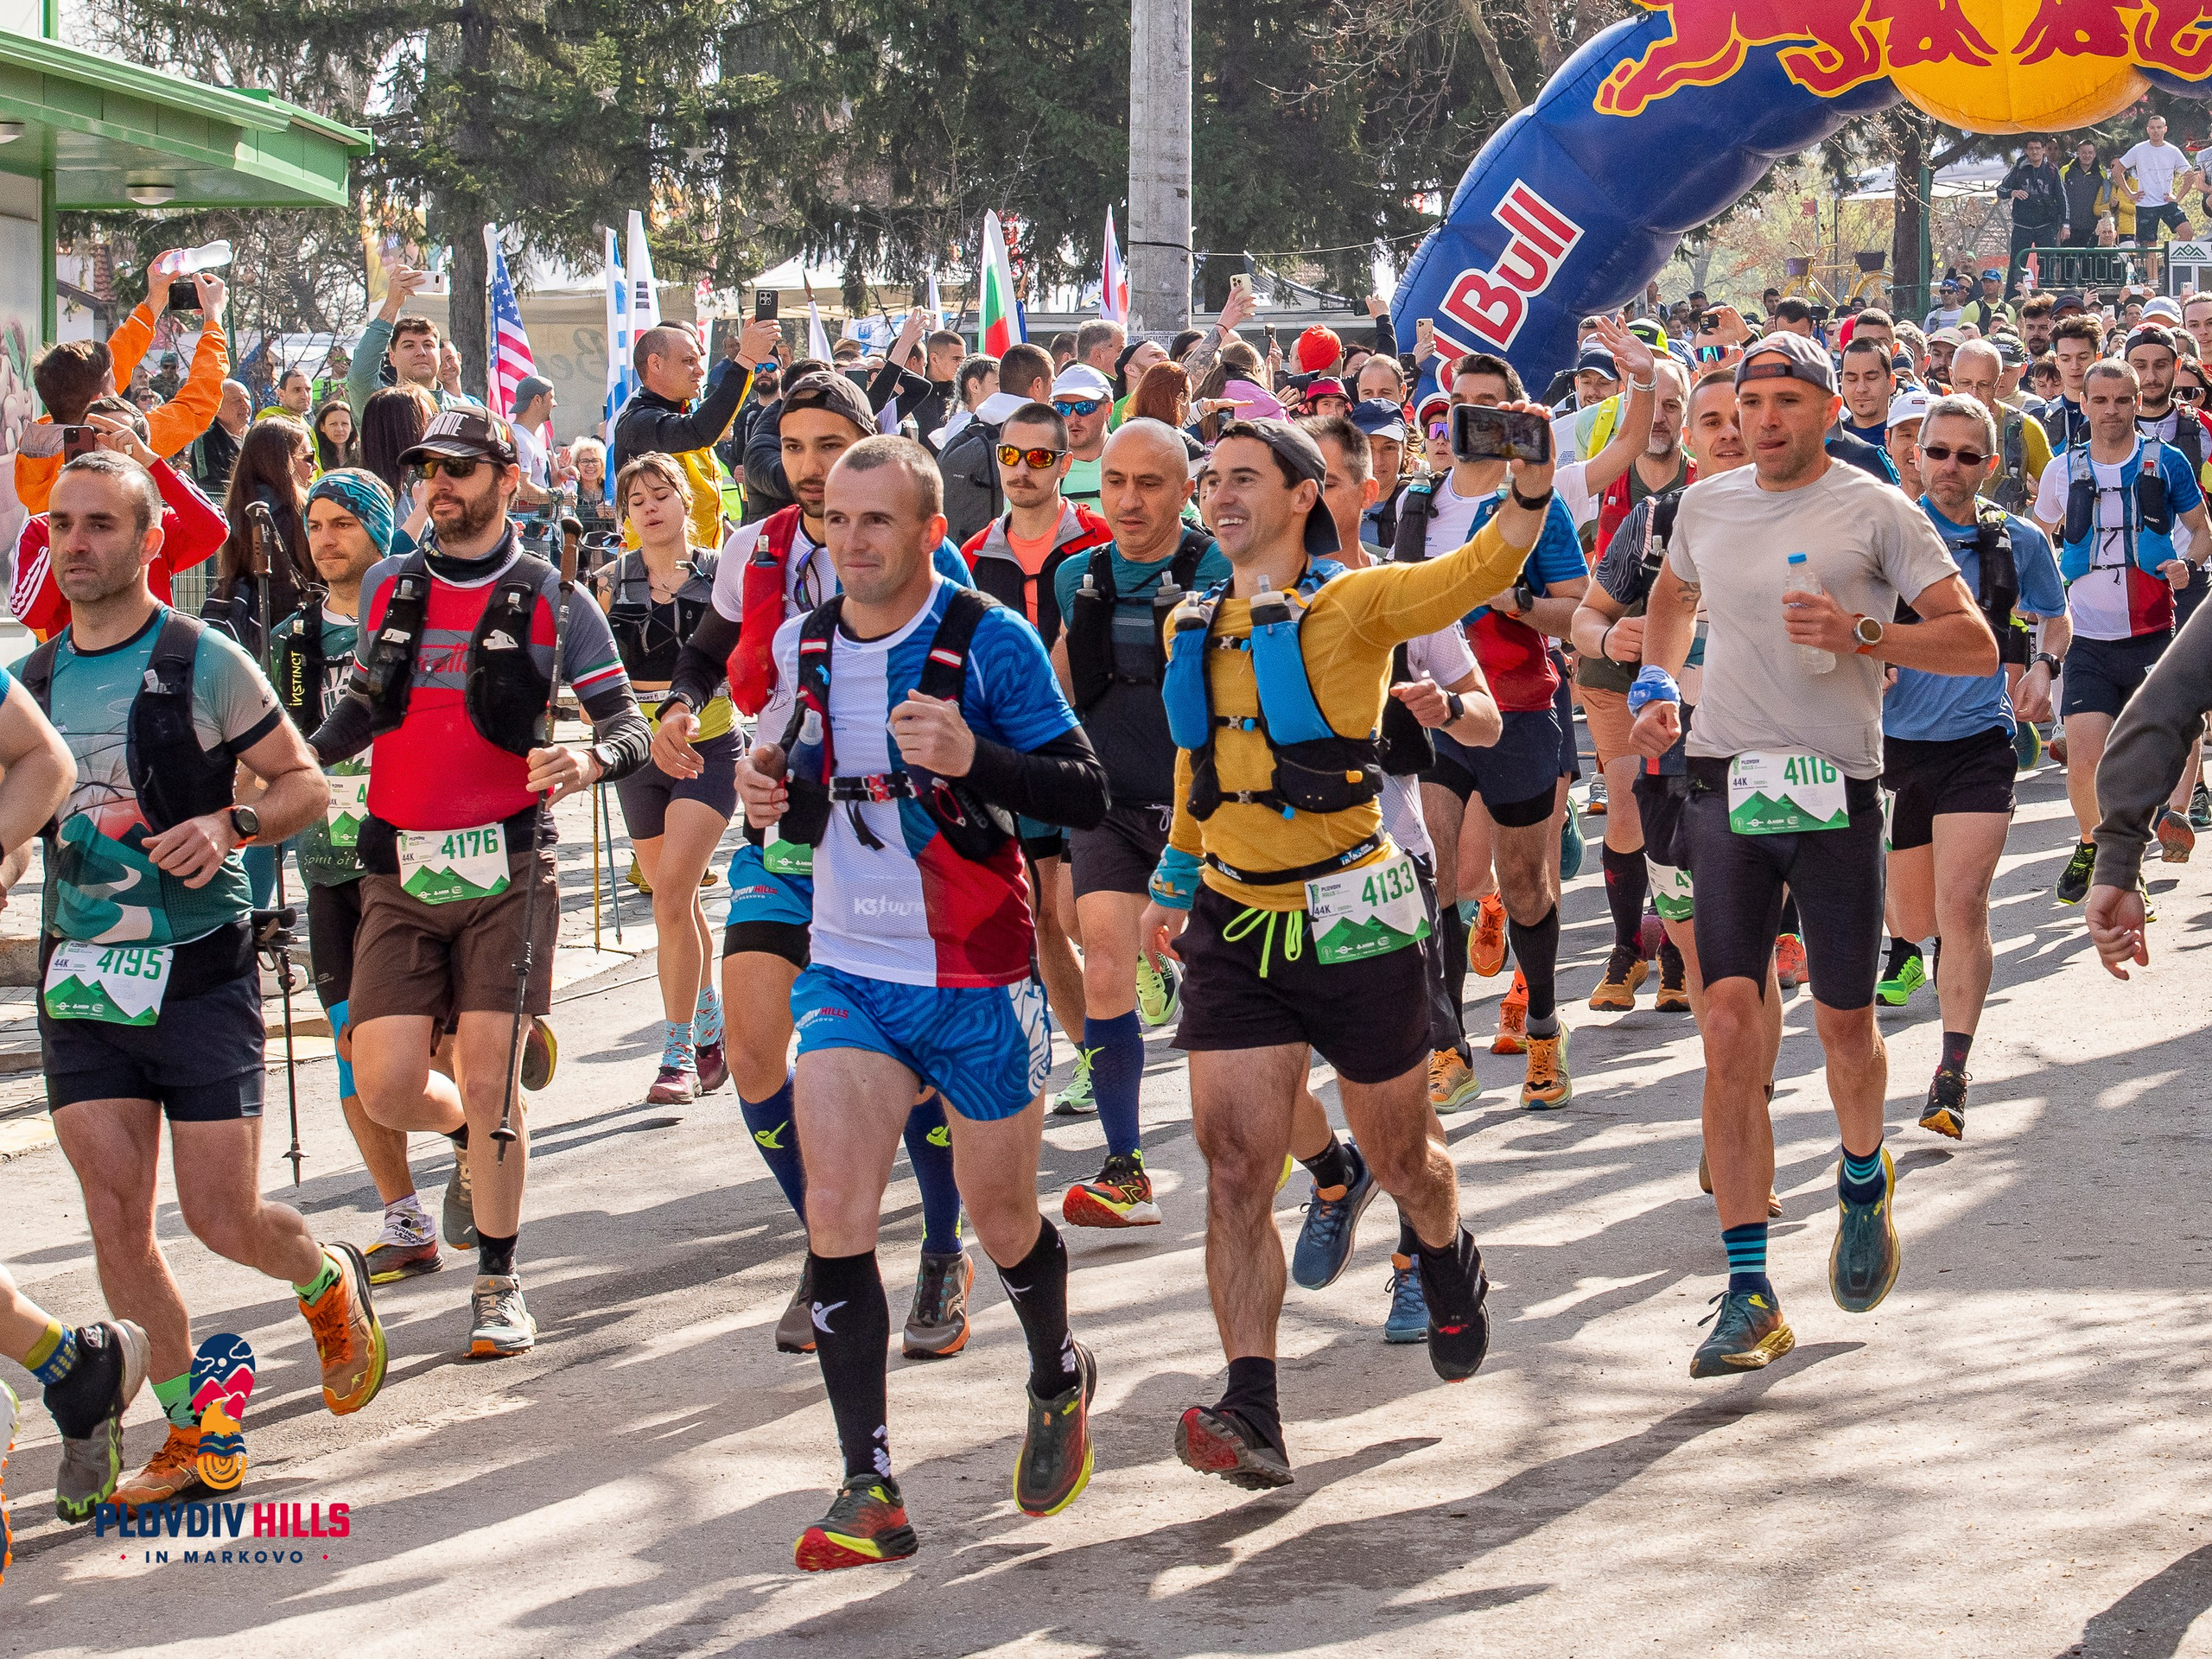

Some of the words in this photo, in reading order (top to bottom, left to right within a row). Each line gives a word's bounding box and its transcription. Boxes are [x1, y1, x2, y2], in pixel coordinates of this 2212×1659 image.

[1441, 181, 1582, 349] Bull
[1783, 755, 1838, 786] 4116
[1732, 778, 1748, 786] 44K
[441, 828, 499, 860] 4176
[303, 855, 331, 867] Spirit
[336, 855, 352, 865] of
[402, 853, 415, 862] 44K
[1362, 861, 1415, 907] 4133
[1314, 905, 1332, 916] 44K
[54, 958, 70, 969] 44K
[96, 949, 164, 981] 4195
[820, 1007, 849, 1020] HILLS
